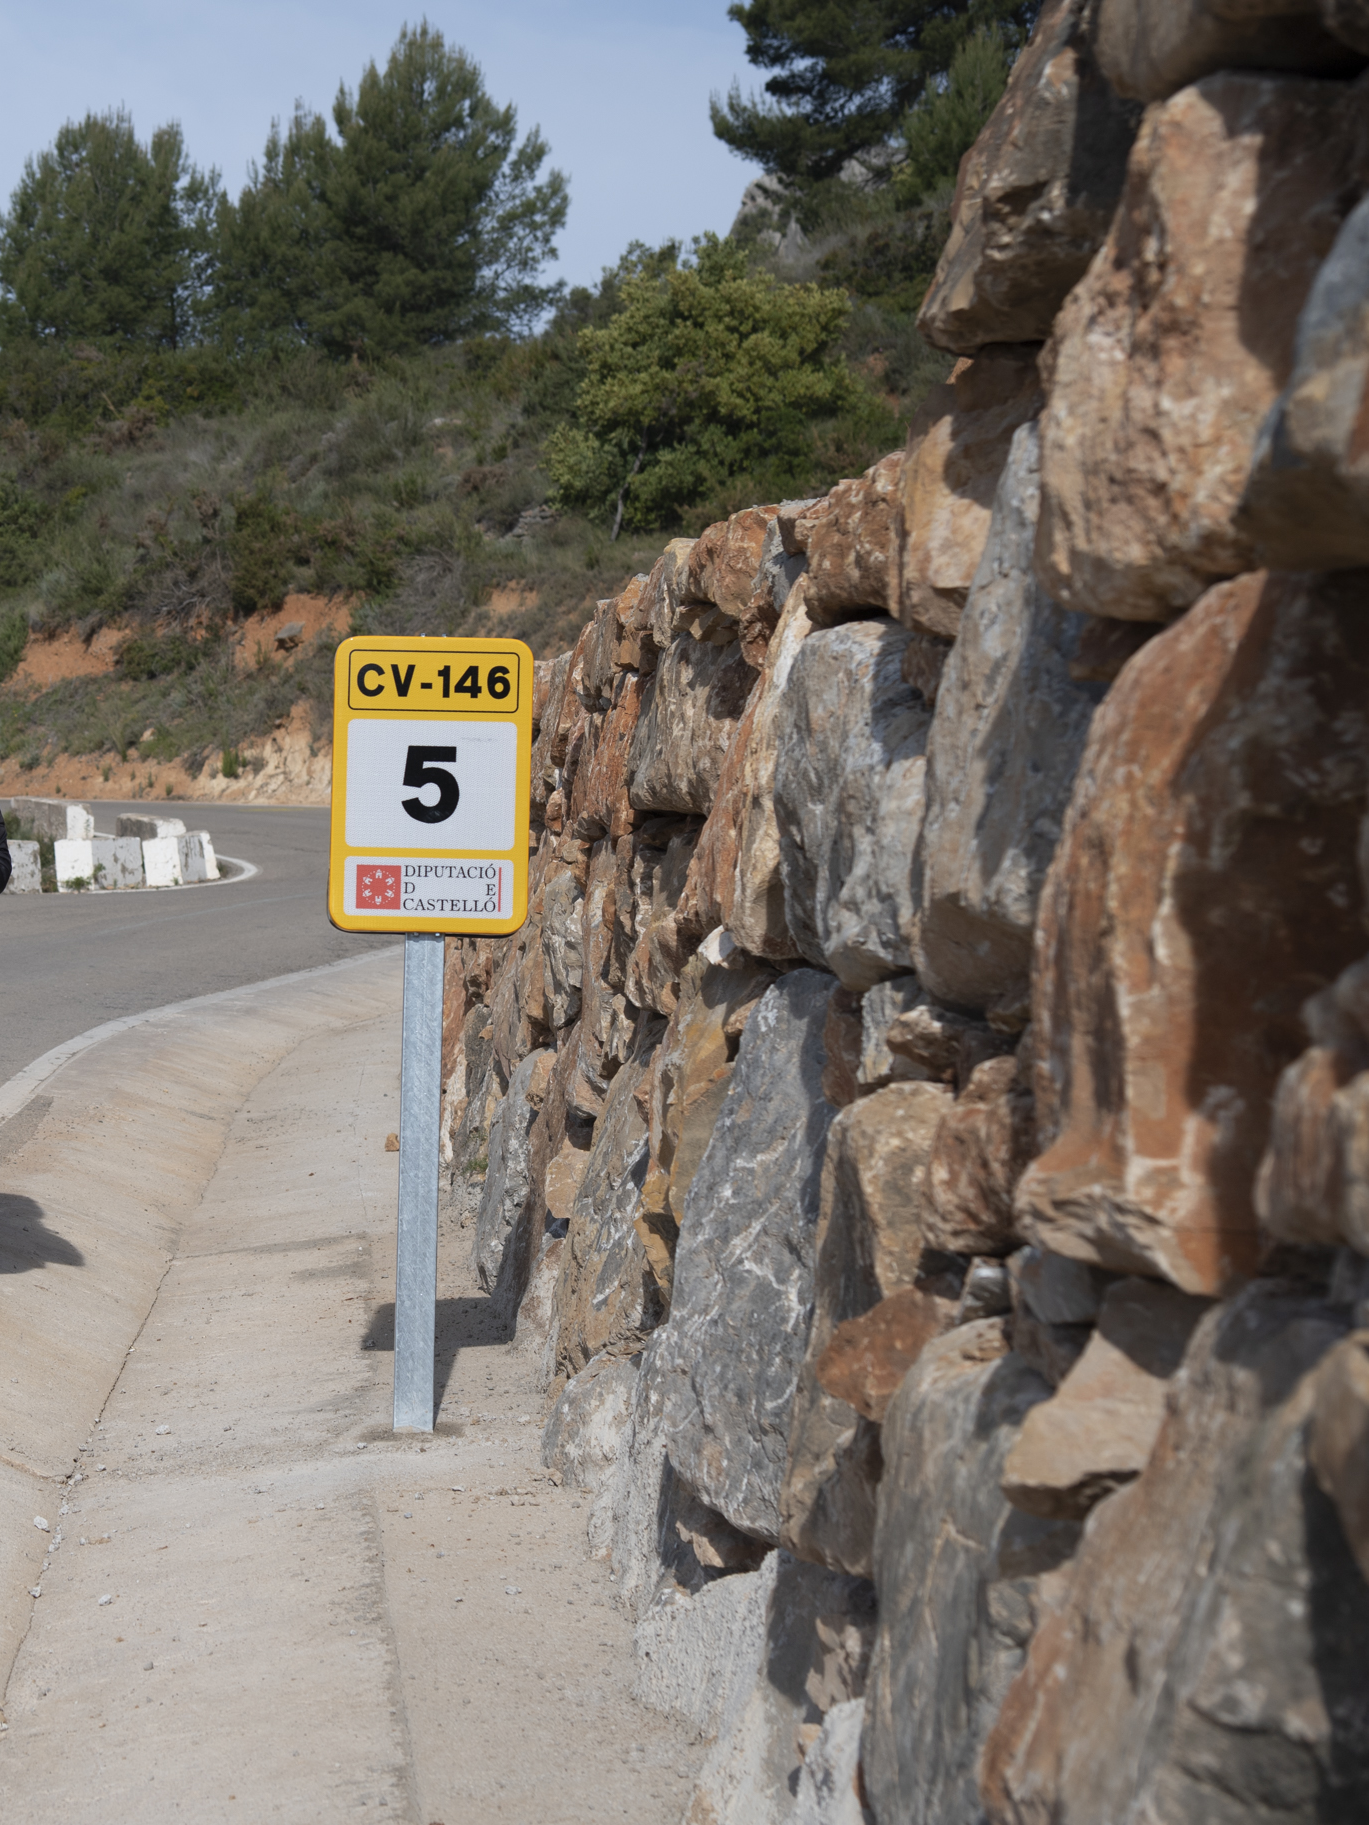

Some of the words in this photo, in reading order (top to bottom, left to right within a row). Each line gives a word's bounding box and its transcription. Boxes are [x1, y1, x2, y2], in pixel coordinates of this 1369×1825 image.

[356, 662, 511, 700] CV-146
[401, 745, 460, 824] 5
[403, 863, 497, 879] DIPUTACIÓ
[403, 896, 497, 913] CASTELLÓ
